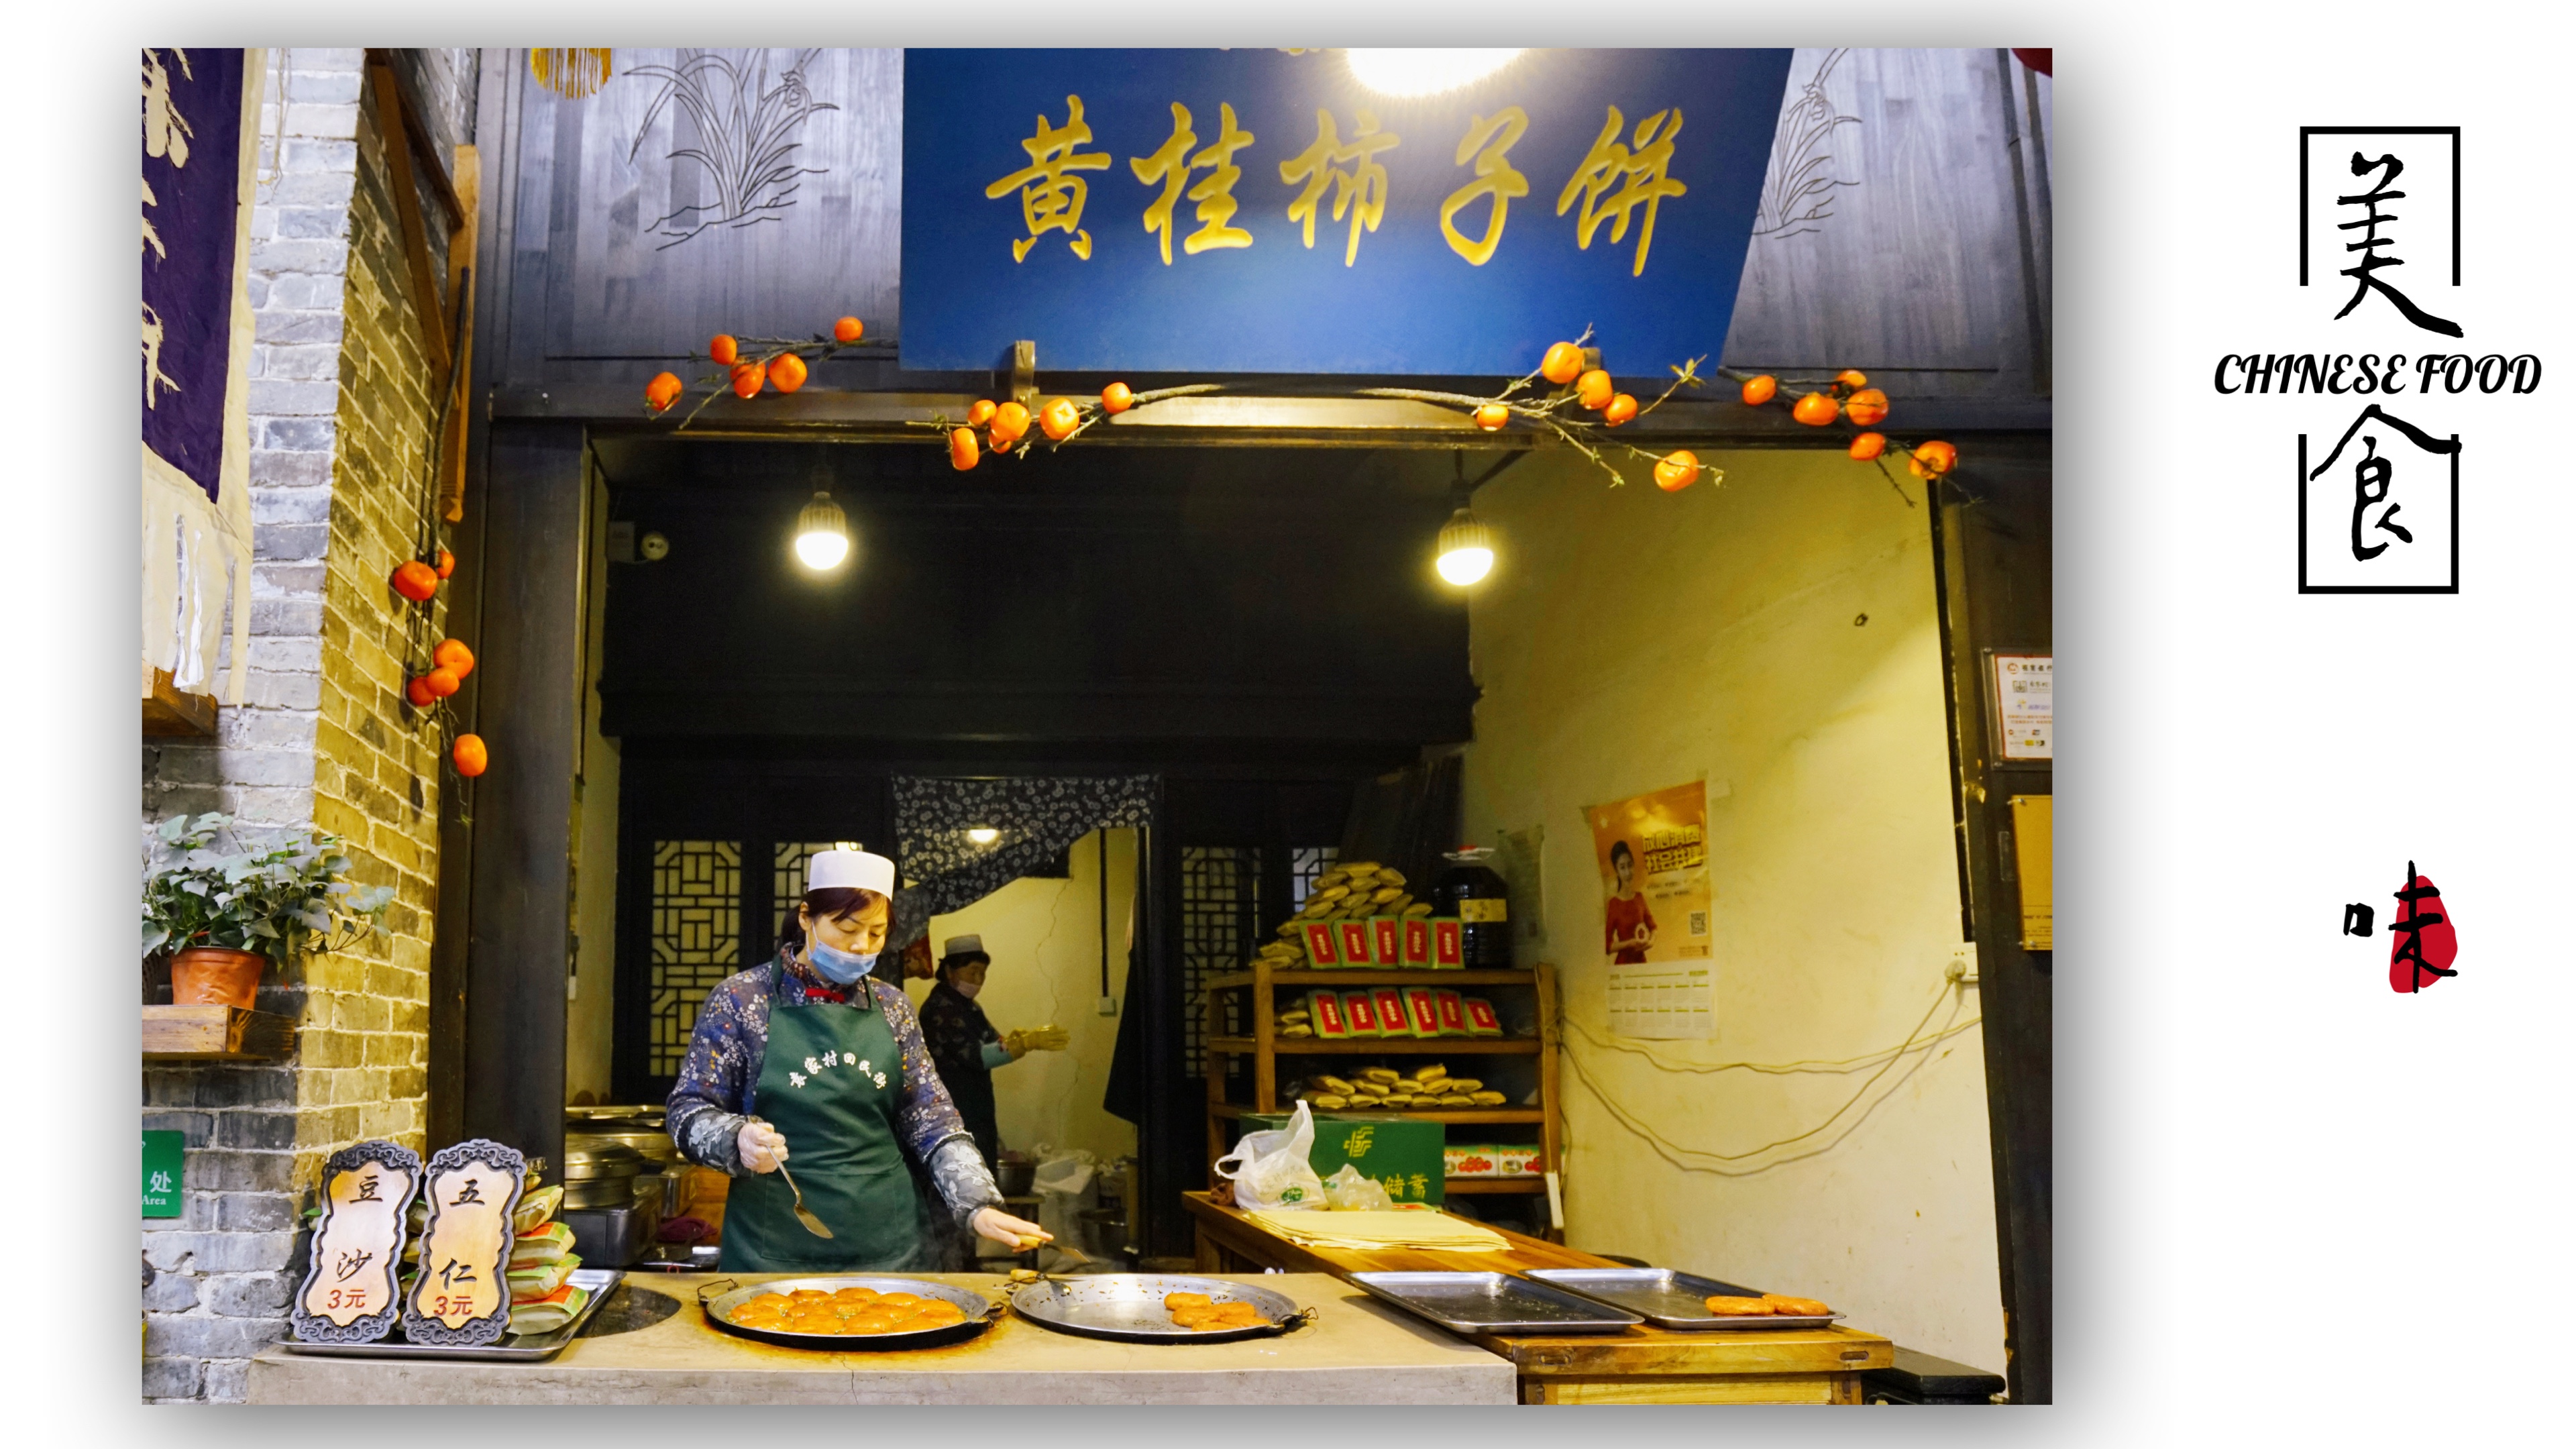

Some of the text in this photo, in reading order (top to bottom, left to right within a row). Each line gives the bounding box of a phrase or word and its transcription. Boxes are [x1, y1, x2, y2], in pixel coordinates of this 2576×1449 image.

[986, 94, 1686, 276] 黄桂柿子饼
[150, 1171, 172, 1193] 处
[1371, 1173, 1429, 1199] 储蓄
[142, 1195, 166, 1205] Area
[337, 1175, 383, 1283] 豆沙
[439, 1179, 485, 1290] 五仁
[327, 1289, 366, 1309] 3元
[433, 1295, 473, 1317] 3元
